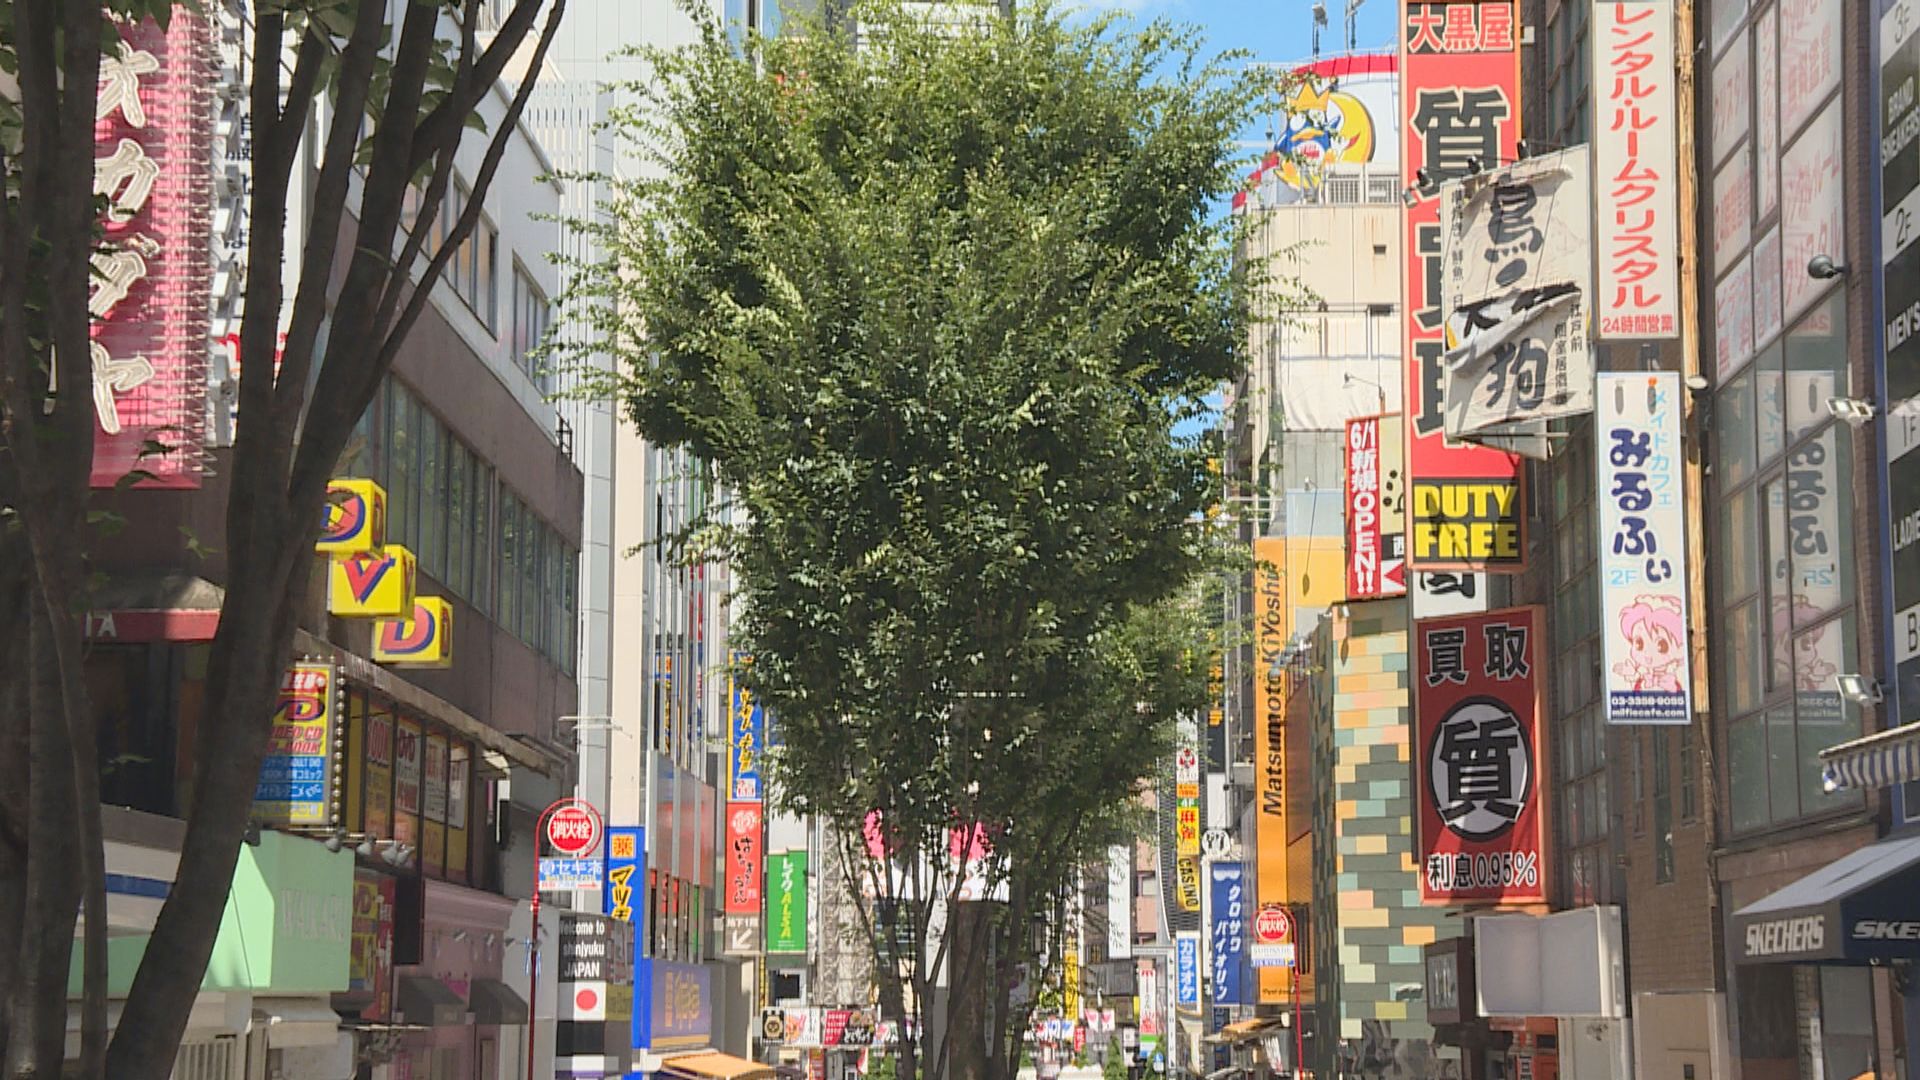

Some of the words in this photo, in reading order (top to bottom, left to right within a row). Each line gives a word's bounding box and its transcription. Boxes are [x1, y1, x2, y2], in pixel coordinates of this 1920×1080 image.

[1408, 3, 1513, 53] 大黒屋
[1602, 314, 1673, 334] 24時間営業
[1887, 301, 1920, 352] MEN'S
[1651, 388, 1673, 506] メイドカフェ
[1413, 484, 1518, 518] DUTY
[1609, 428, 1672, 583] みるふぃ
[1414, 521, 1518, 558] FREE
[338, 552, 396, 605] V
[1610, 569, 1637, 585] 2F
[380, 603, 436, 655] D
[1908, 612, 1920, 652] B
[1426, 622, 1530, 687] 買取
[1262, 671, 1283, 818] Matsumoto
[1437, 712, 1525, 826] 質
[552, 820, 590, 840] 消火栓
[595, 920, 606, 936] to
[1229, 886, 1242, 952] クロサワ
[1745, 915, 1825, 956] SKECHERS
[1852, 920, 1920, 940] SKE
[564, 961, 601, 978] JAPAN
[1179, 940, 1196, 1000] カラオケ
[1214, 920, 1228, 1001] バイオリン
